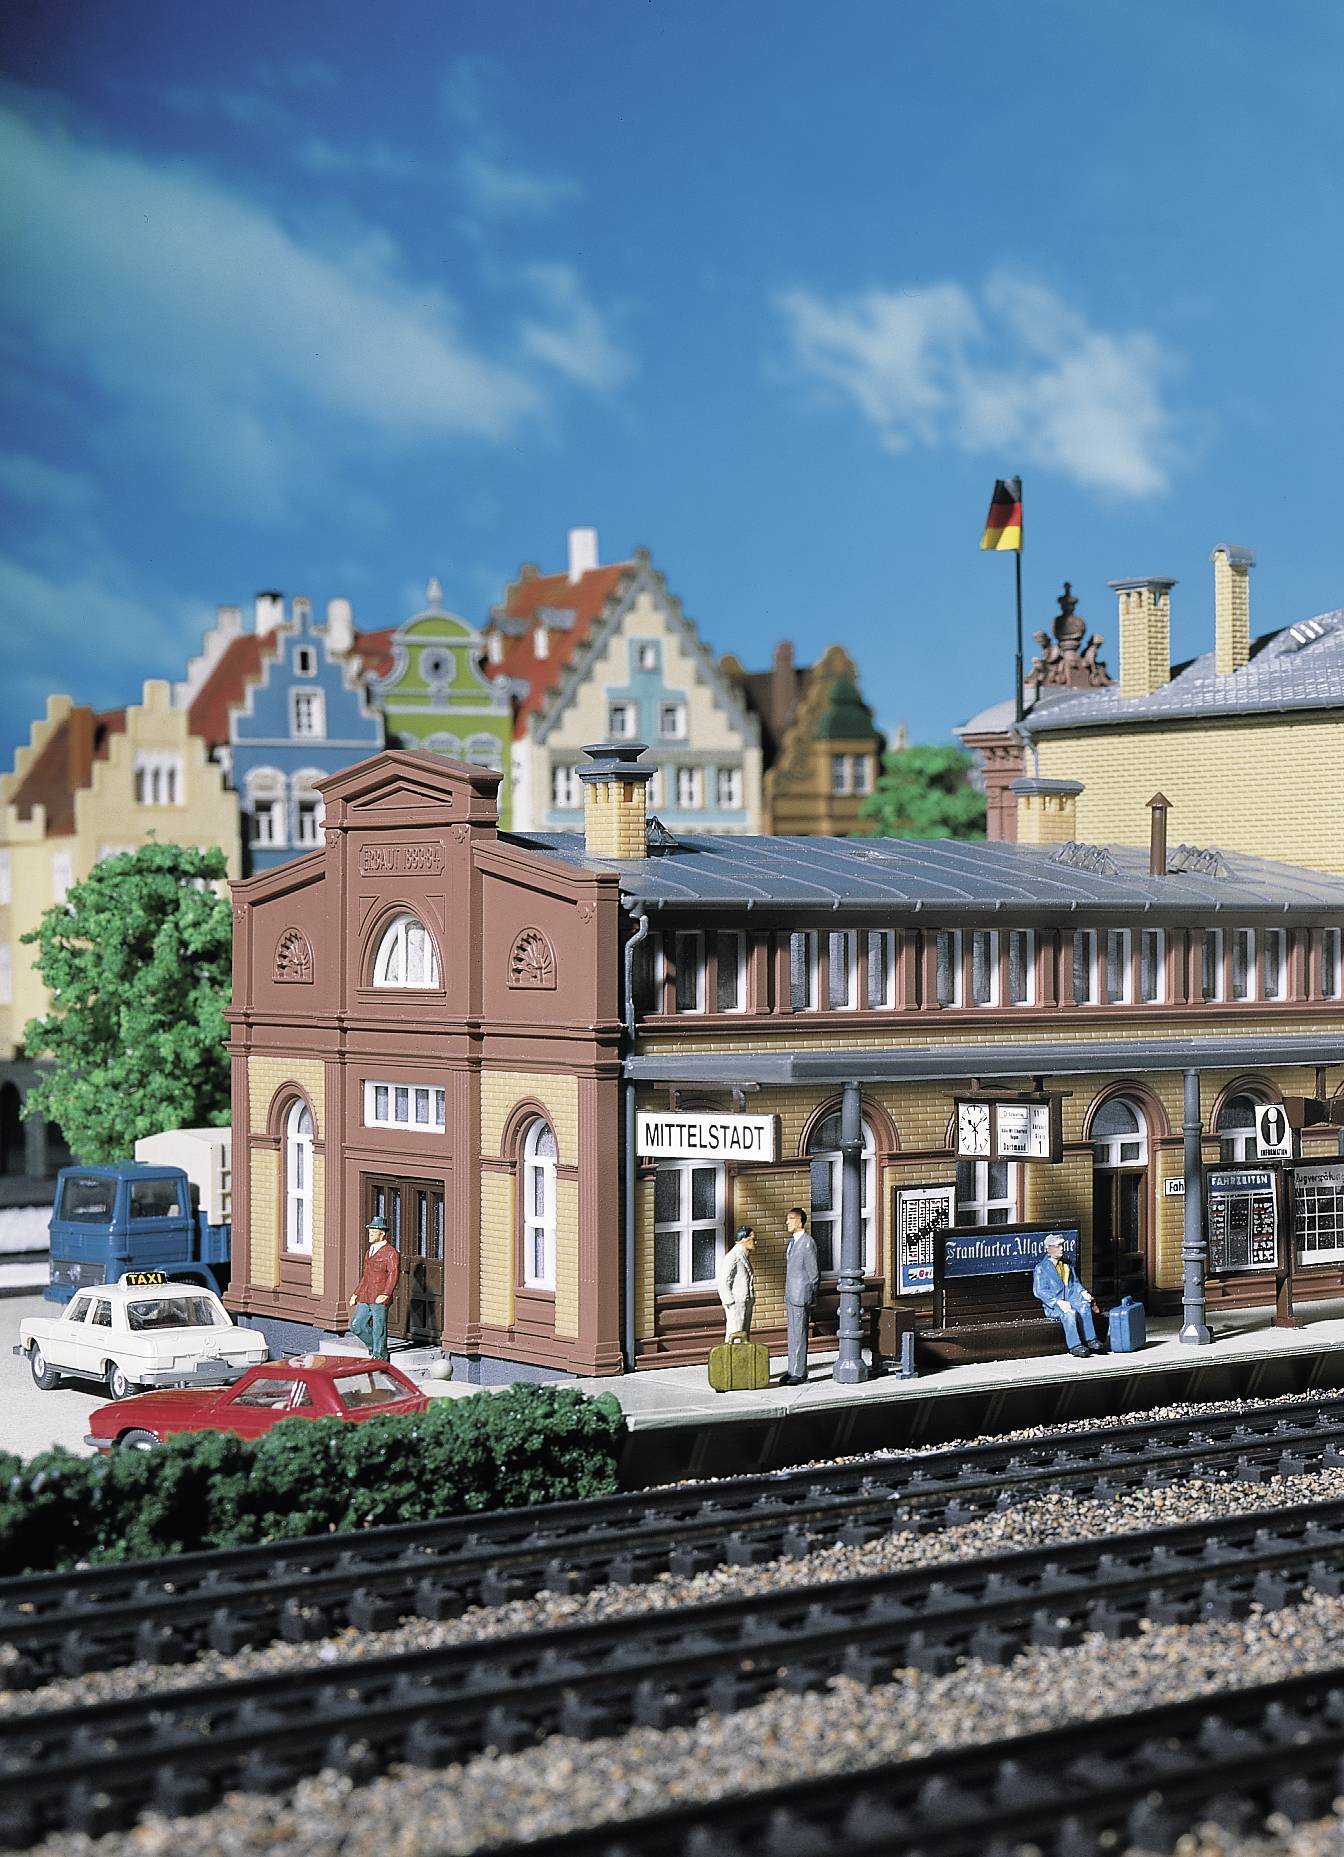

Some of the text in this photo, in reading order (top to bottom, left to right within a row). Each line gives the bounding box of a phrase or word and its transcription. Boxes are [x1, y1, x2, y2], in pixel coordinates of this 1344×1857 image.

[364, 848, 400, 871] ERBAUT
[645, 1123, 765, 1150] MITTELSTADT
[1169, 1181, 1185, 1192] Fah
[1211, 1175, 1268, 1186] FAHRZEITEN
[945, 1237, 1076, 1261] Frankfurter Allgene
[129, 1273, 162, 1285] TAXI
